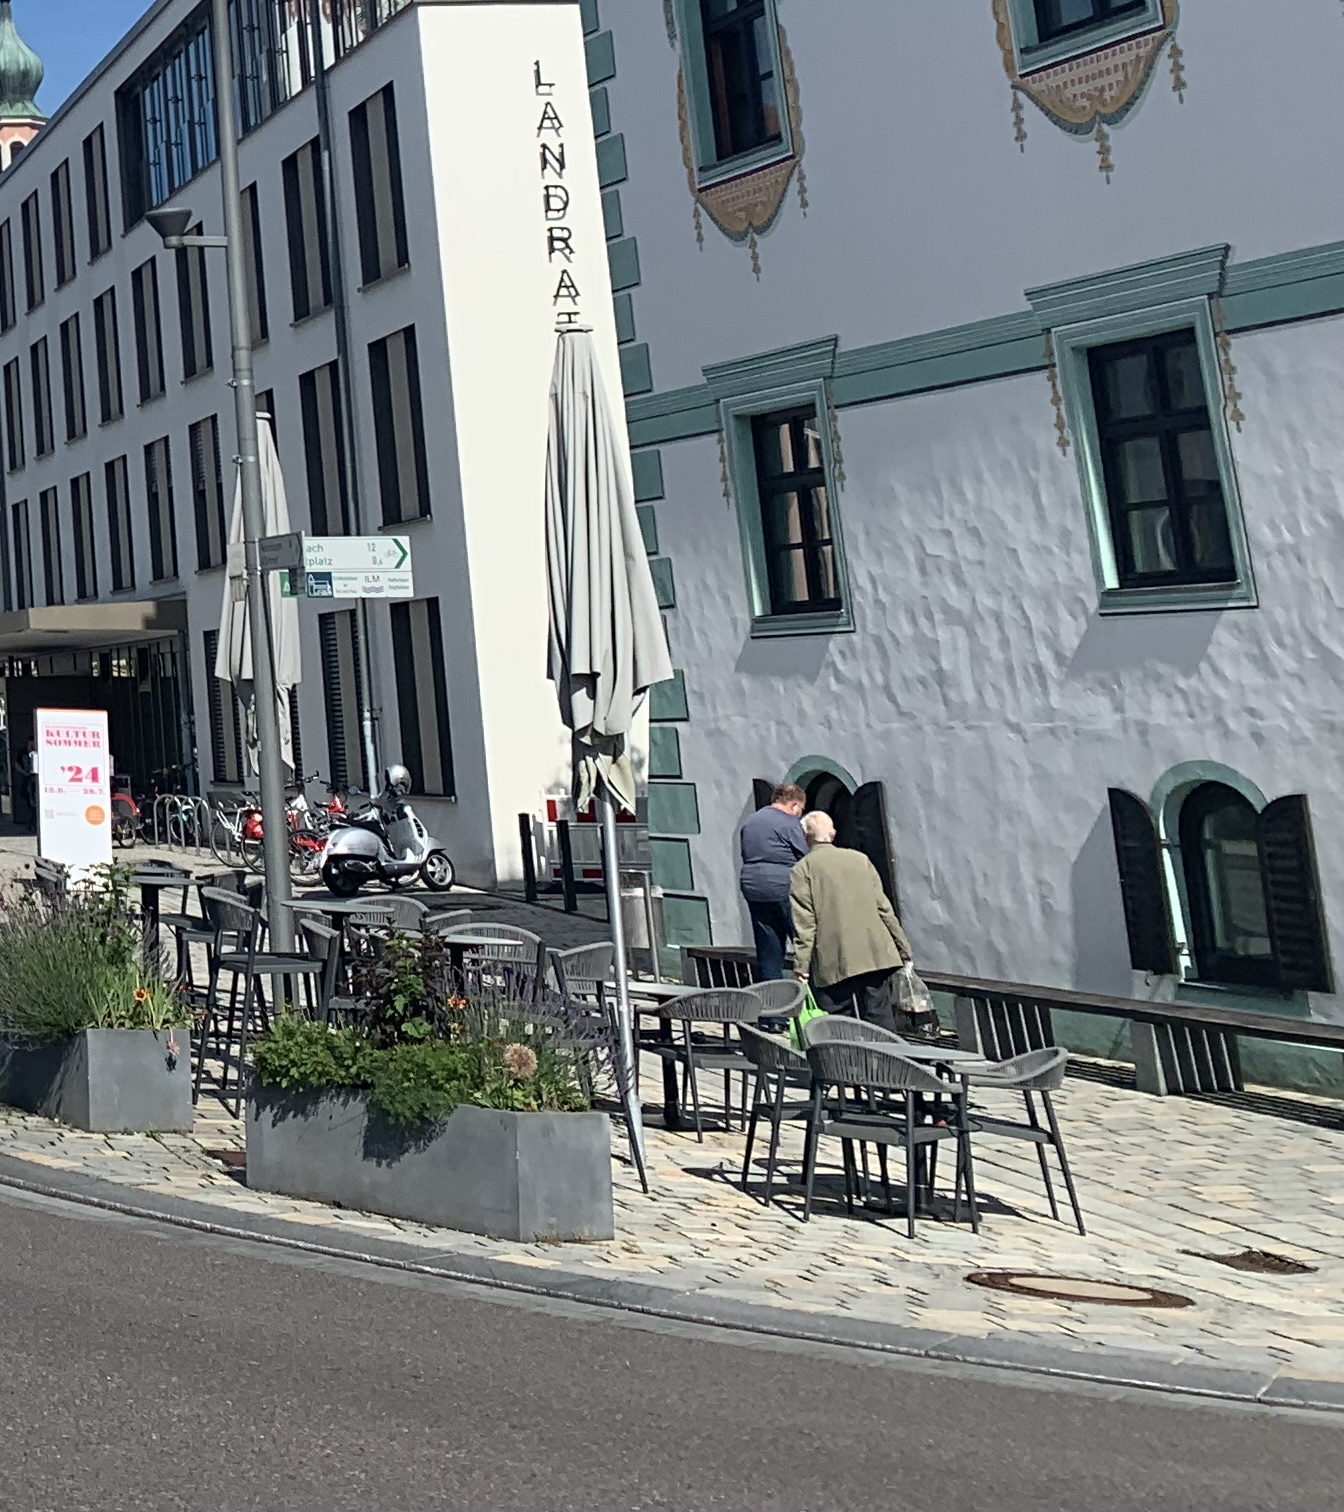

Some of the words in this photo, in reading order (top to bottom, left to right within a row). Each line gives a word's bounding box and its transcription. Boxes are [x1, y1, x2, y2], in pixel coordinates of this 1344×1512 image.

[305, 542, 324, 554] ach
[367, 542, 377, 552] 12
[364, 574, 381, 583] ILM
[45, 729, 101, 739] KULTUR
[45, 739, 101, 748] SOMMER
